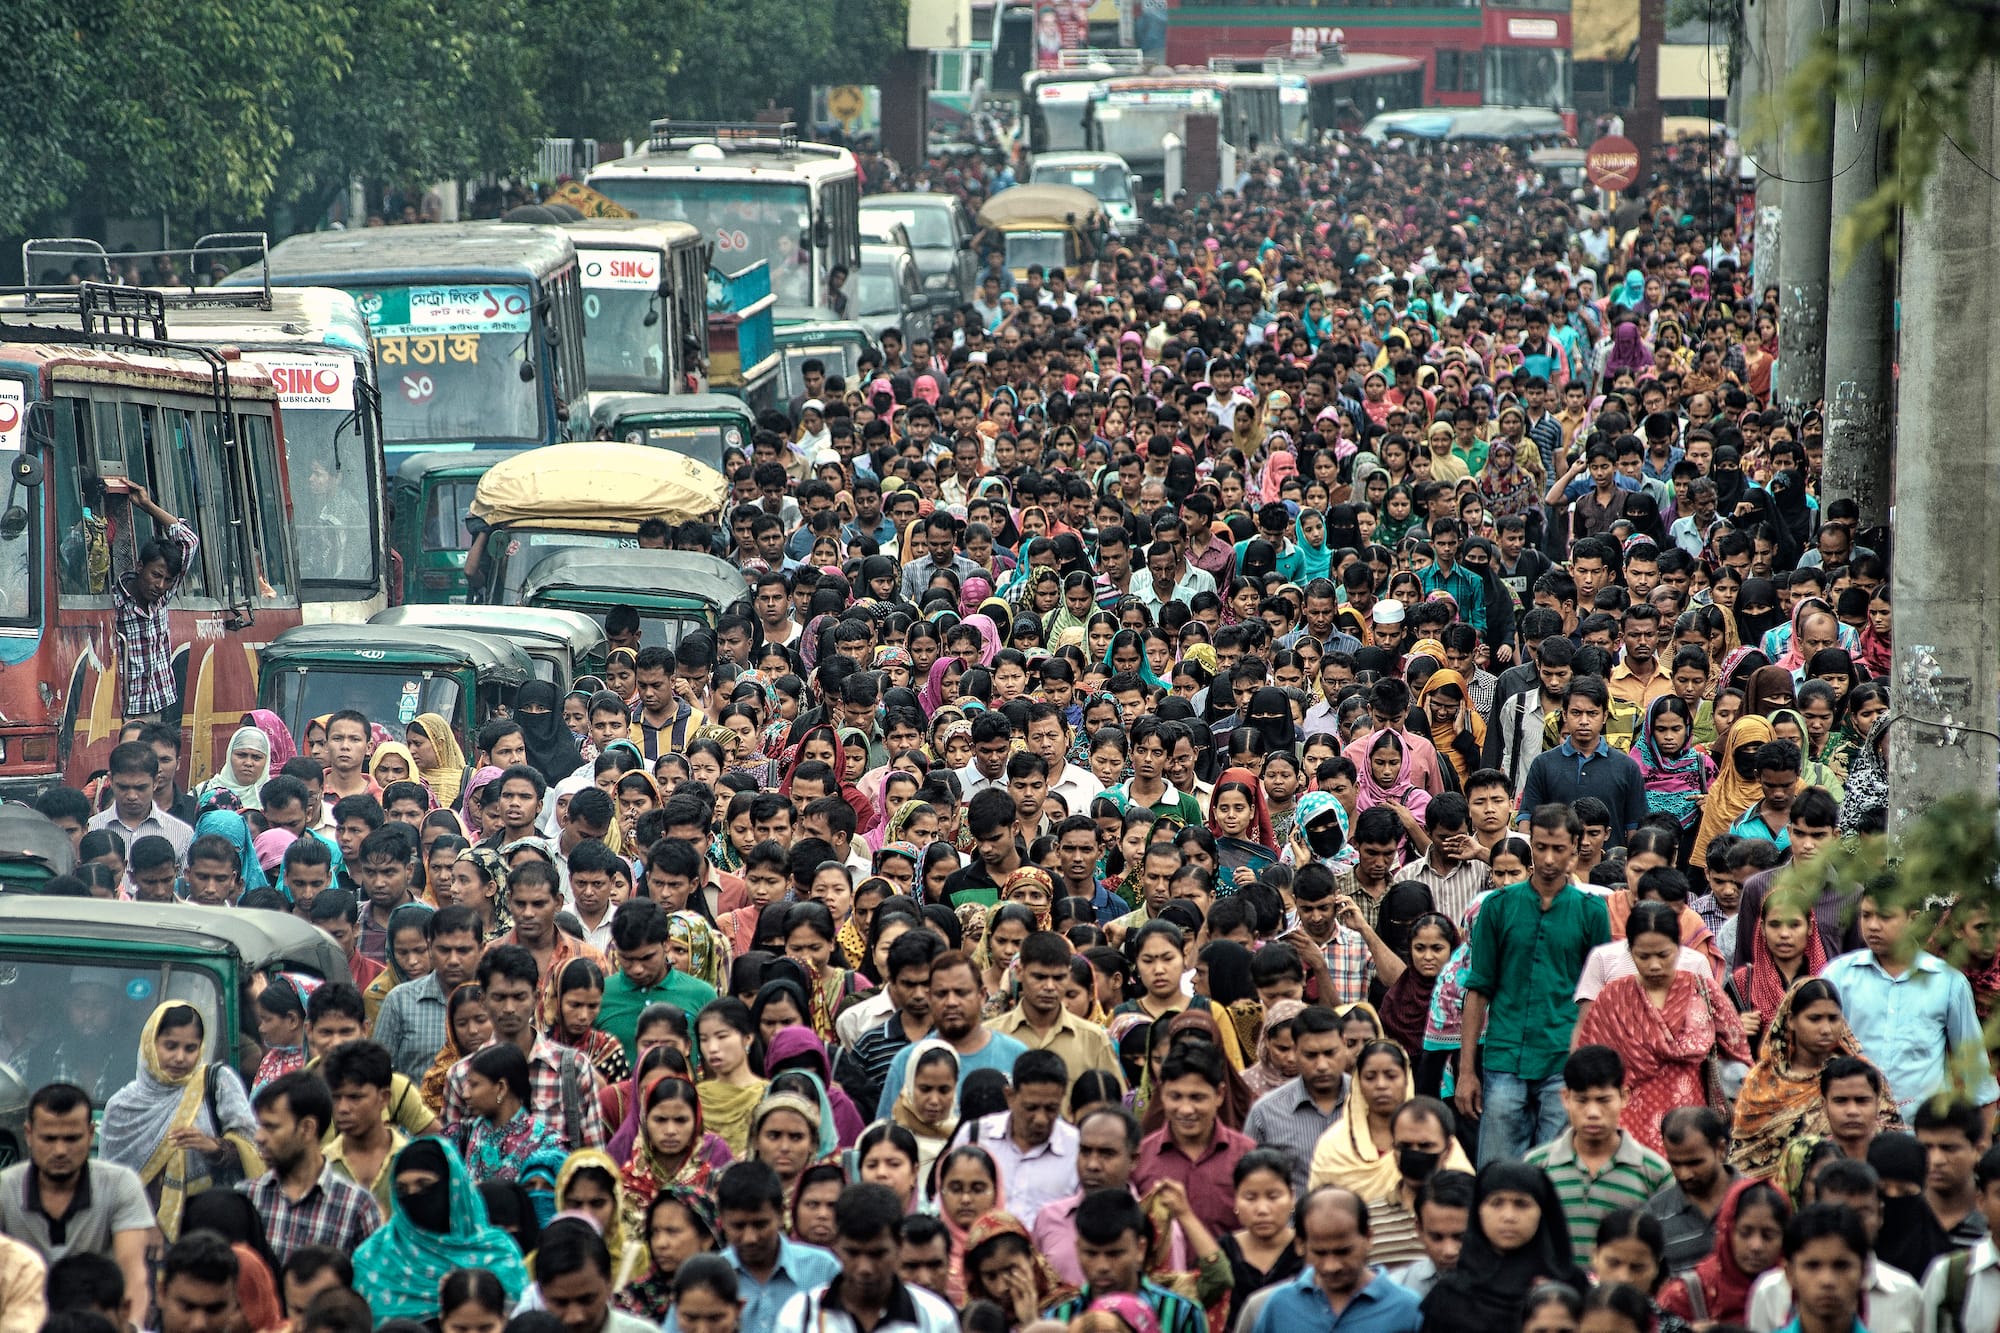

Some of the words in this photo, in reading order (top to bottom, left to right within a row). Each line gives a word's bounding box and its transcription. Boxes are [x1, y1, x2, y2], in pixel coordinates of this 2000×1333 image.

[610, 260, 654, 278] SINO
[482, 288, 526, 319] ১০
[314, 361, 339, 369] Young
[272, 368, 340, 395] SINO
[402, 375, 433, 399] ১০
